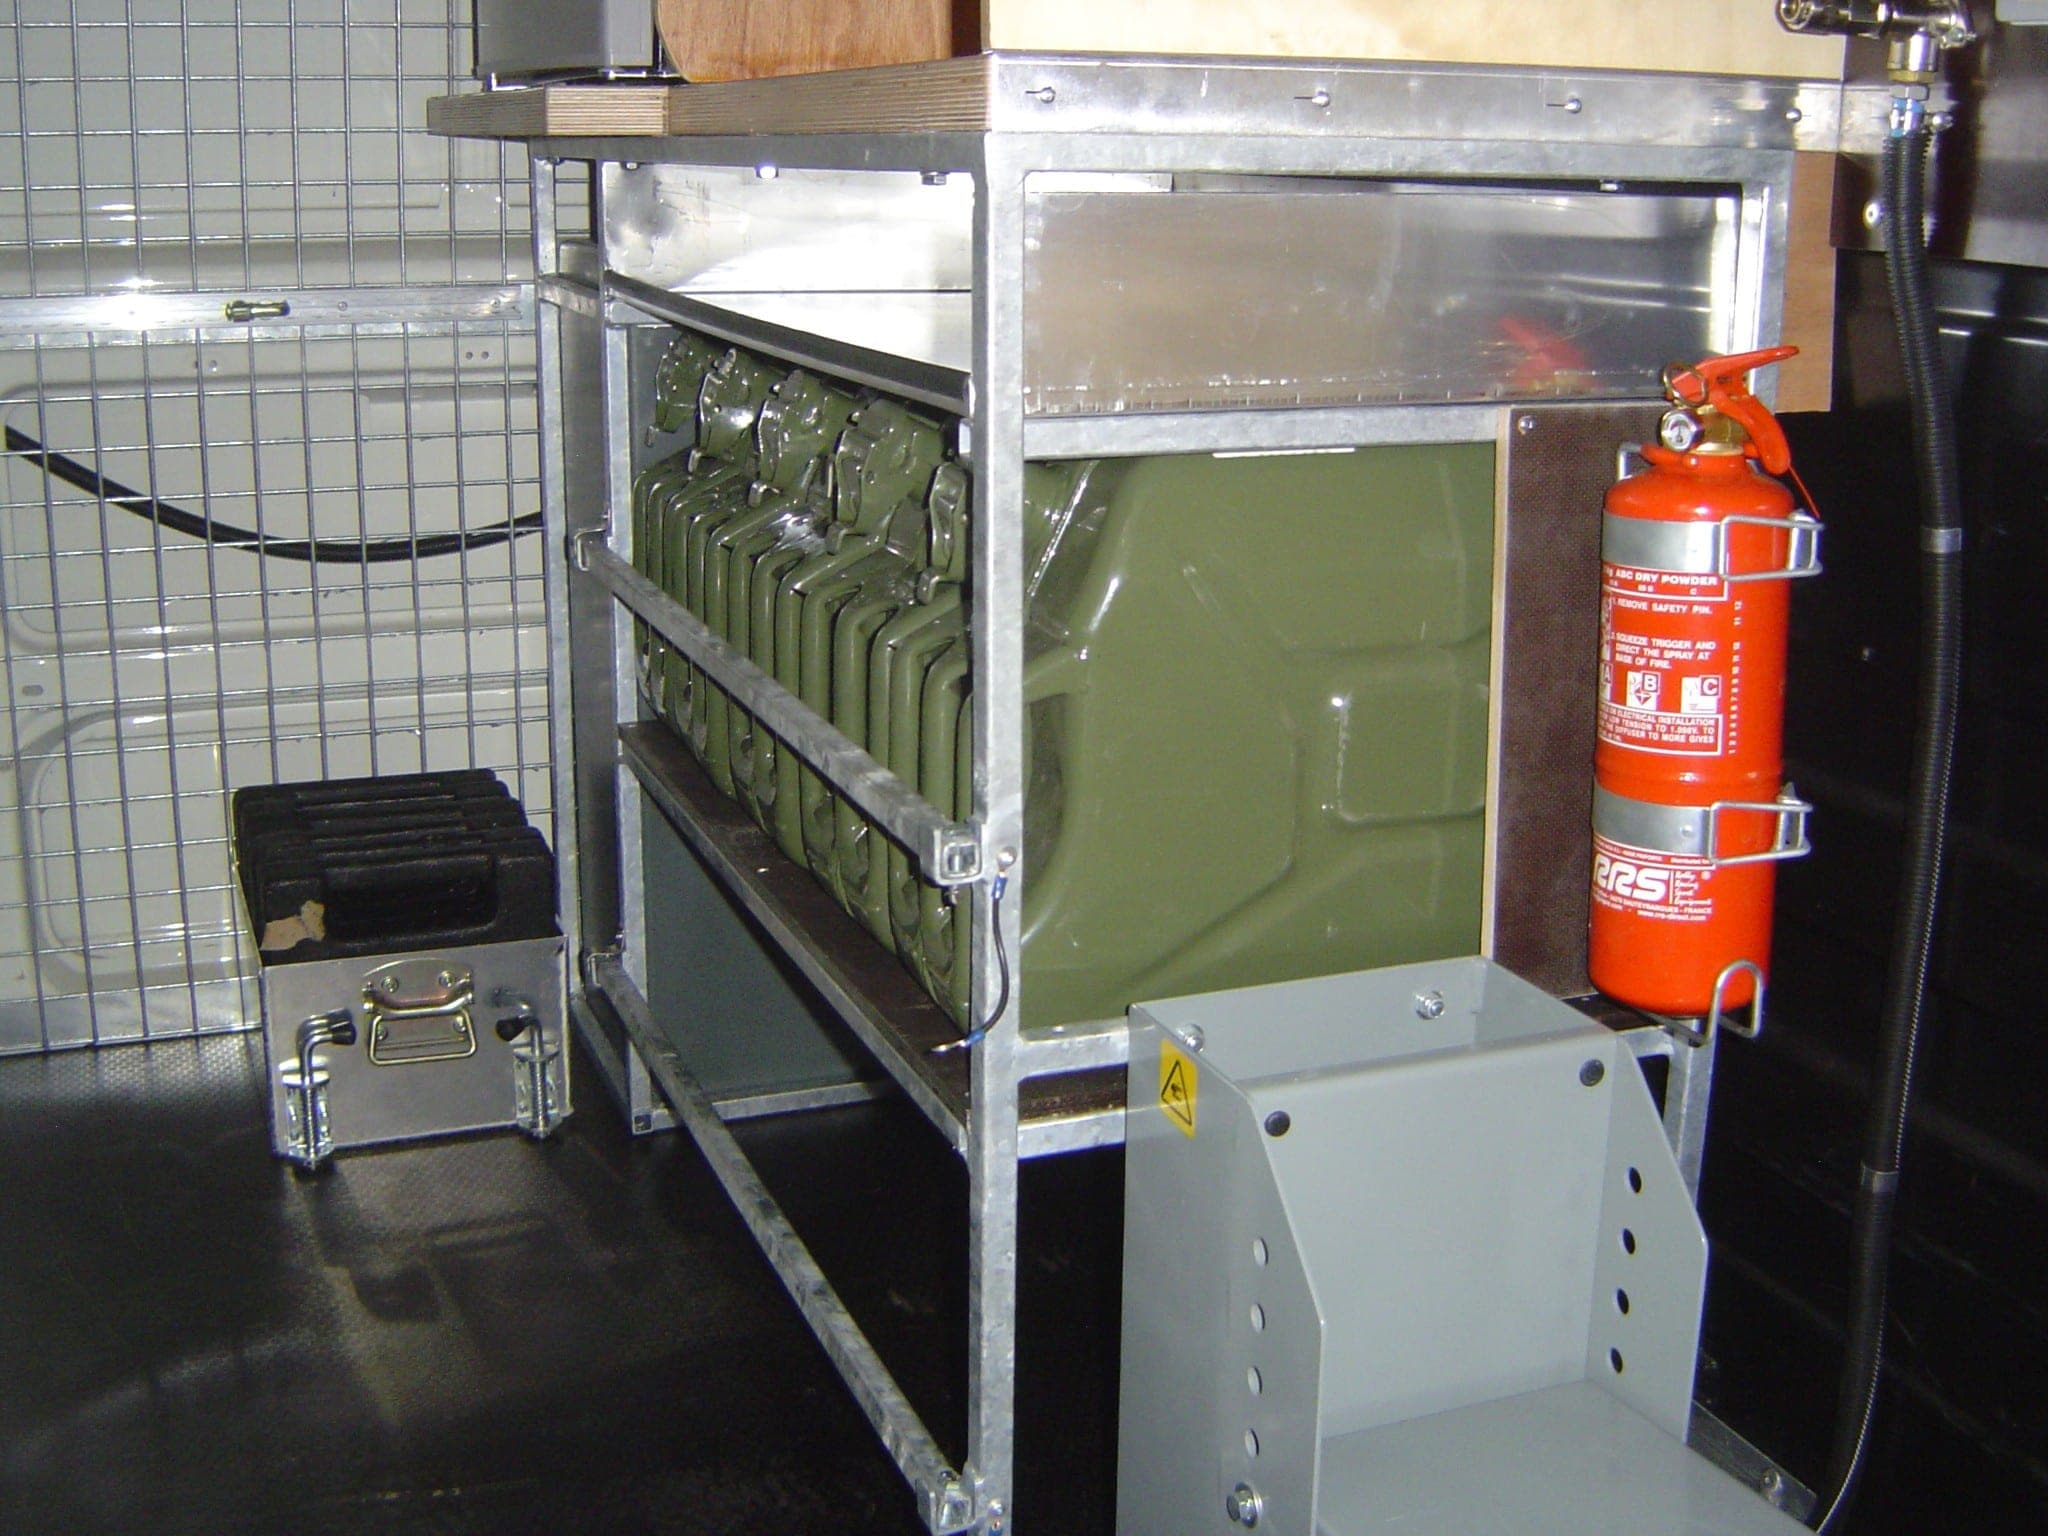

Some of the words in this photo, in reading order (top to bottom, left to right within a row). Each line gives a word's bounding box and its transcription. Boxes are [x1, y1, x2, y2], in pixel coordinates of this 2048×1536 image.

[1615, 569, 1633, 580] ABC
[1635, 572, 1659, 583] DRY
[1661, 574, 1718, 586] POWDER
[1618, 598, 1648, 610] REMOVE
[1652, 602, 1688, 613] SAFETY
[1692, 605, 1712, 614] PIN.
[1616, 632, 1648, 645] SQUEEZE
[1651, 637, 1691, 649] TRIGGER
[1695, 640, 1716, 649] AND
[1616, 642, 1640, 654] DIRECT
[1643, 647, 1659, 657] THE
[1663, 650, 1694, 660] SPRAY
[1696, 651, 1710, 660] AT
[1615, 652, 1632, 664] BASE
[1635, 657, 1647, 666] OF
[1649, 658, 1672, 669] FIRE.
[1643, 673, 1657, 691] B
[1702, 678, 1718, 695] C
[1617, 710, 1656, 723] ELECTRICAL
[1658, 716, 1715, 726] INSTALLATION
[1622, 718, 1652, 730] TENSION
[1656, 724, 1666, 732] TO
[1703, 727, 1715, 735] TO
[1615, 725, 1645, 738] DIFFUSER
[1648, 731, 1659, 741] TO
[1662, 734, 1686, 743] MORE
[1689, 734, 1714, 743] GIVES
[1593, 853, 1670, 902] RRS
[1684, 906, 1712, 915] FRANCE
